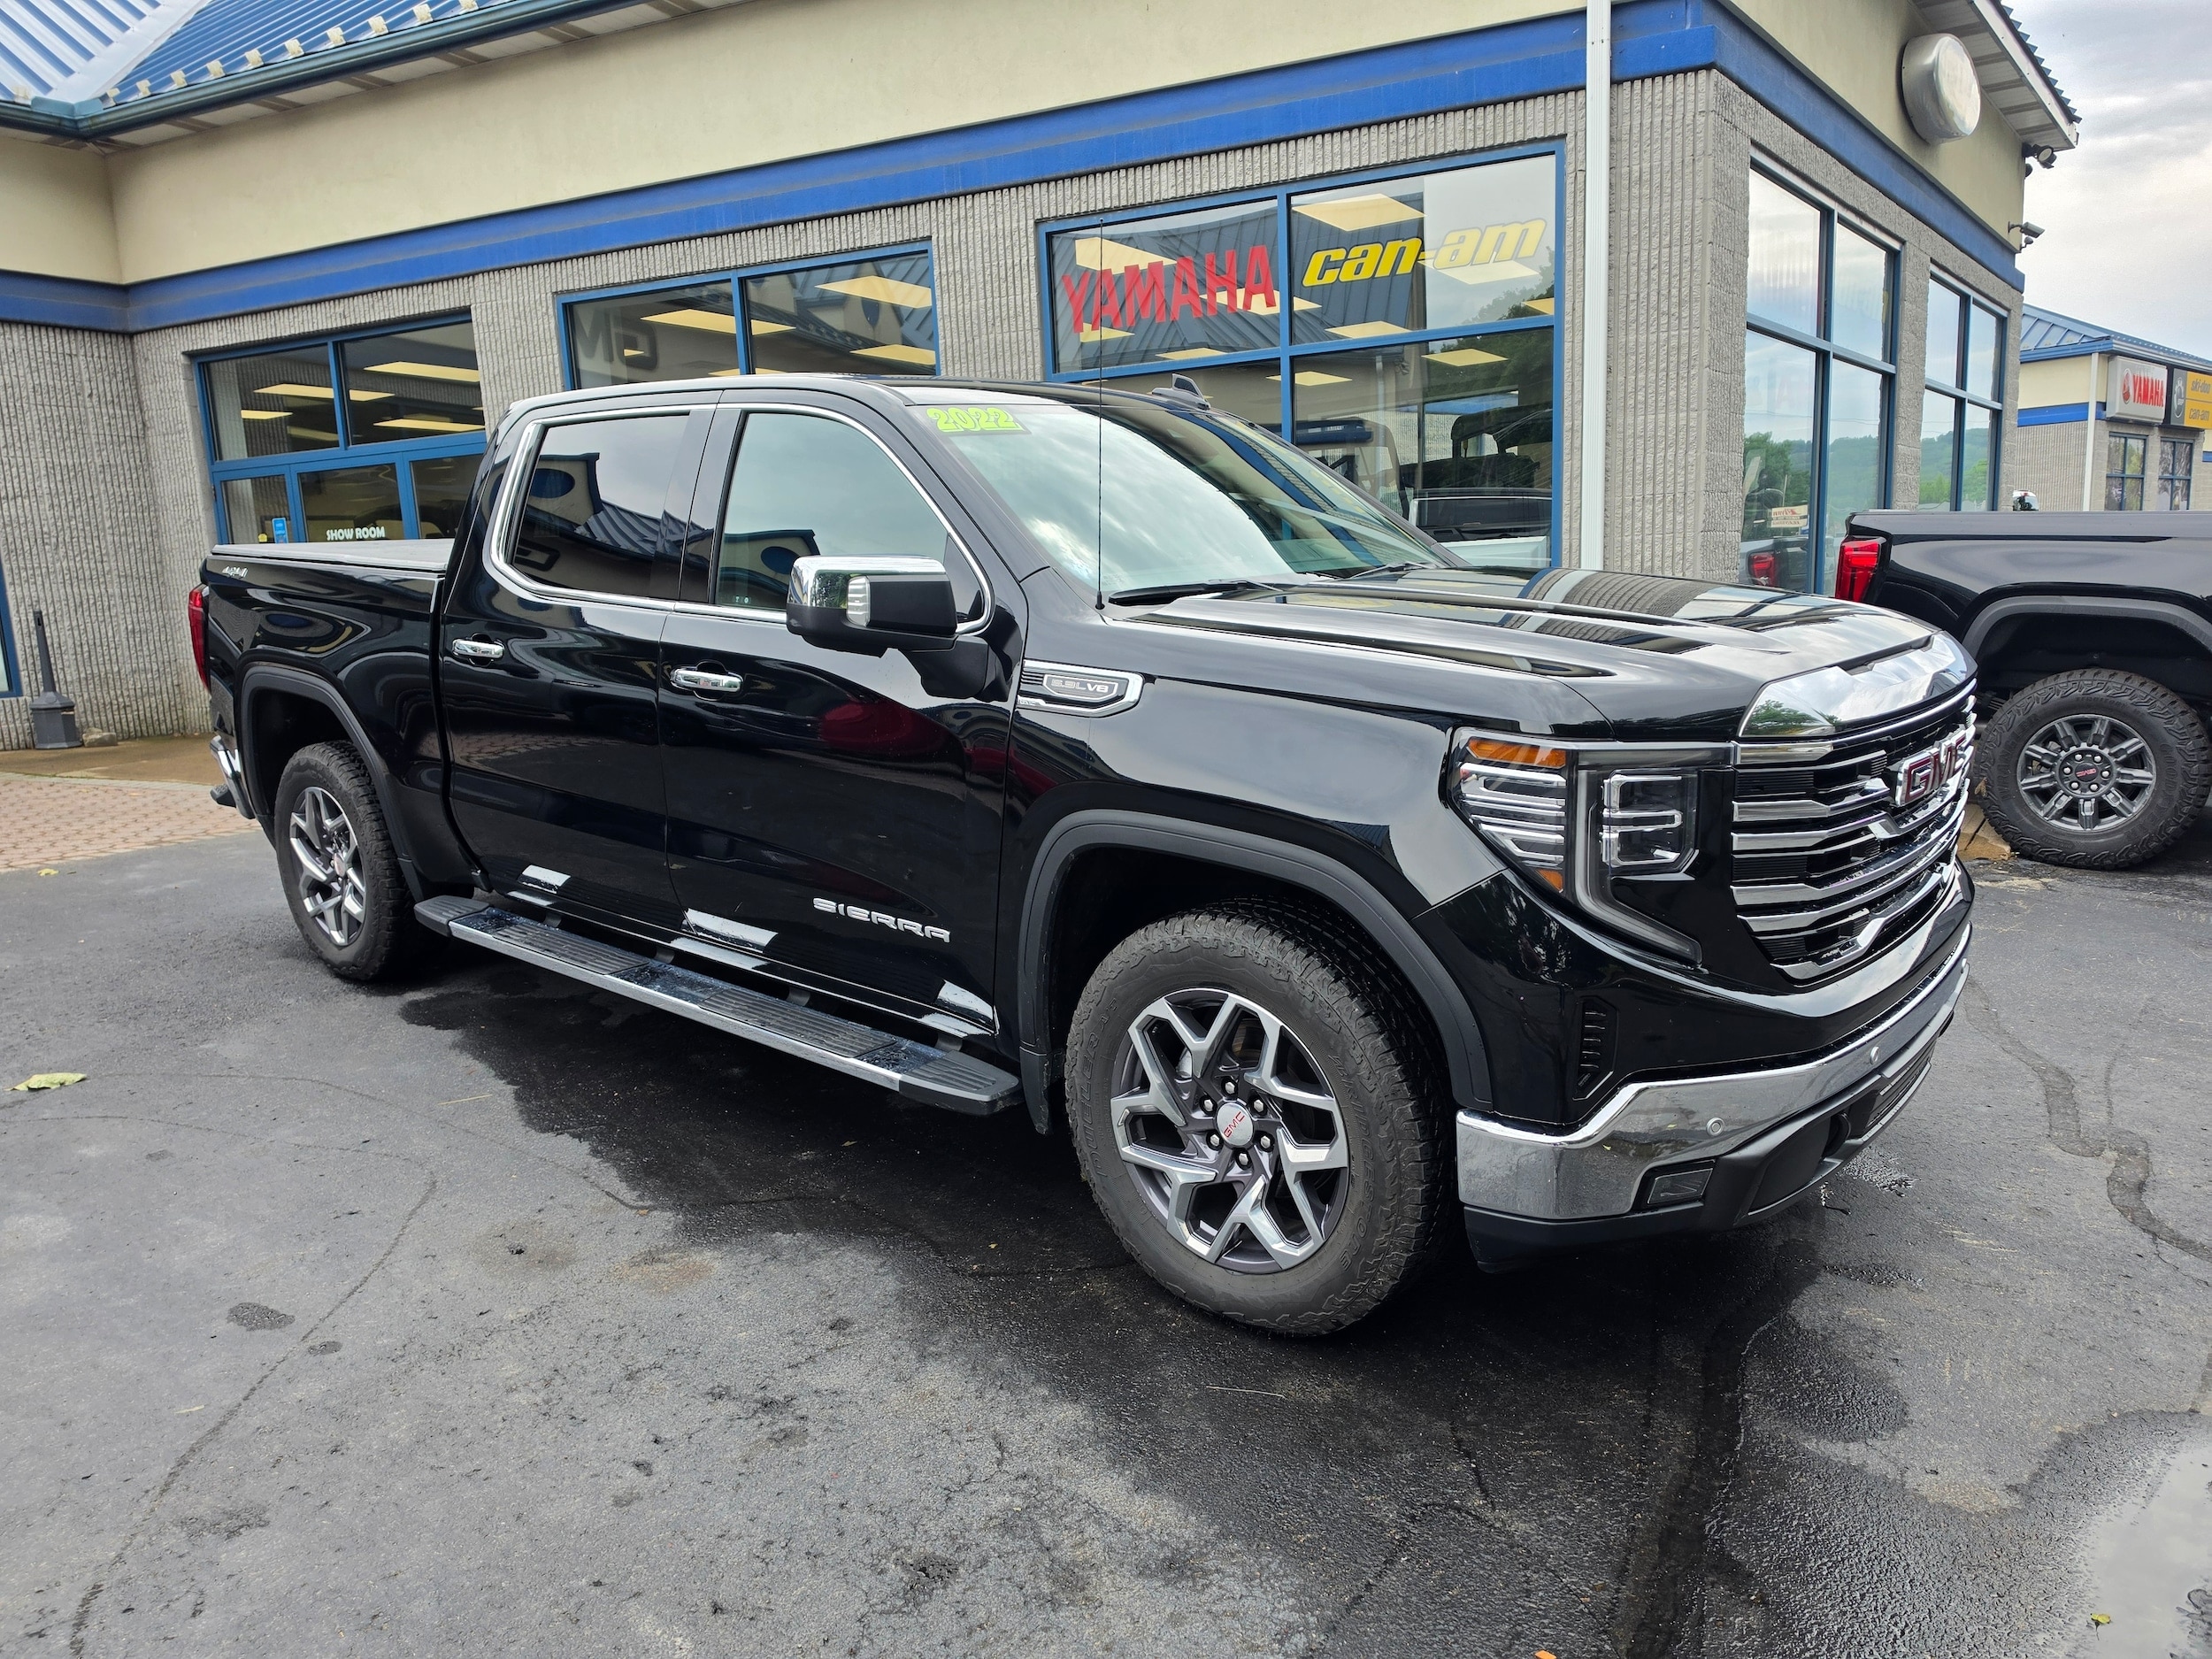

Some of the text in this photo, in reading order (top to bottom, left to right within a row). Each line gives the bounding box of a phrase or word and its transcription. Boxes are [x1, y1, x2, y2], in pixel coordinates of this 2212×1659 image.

[1302, 219, 1547, 288] can-am
[1061, 244, 1277, 334] YAMAHA
[2132, 375, 2163, 407] YAMAHA
[926, 407, 1025, 433] 2022
[326, 526, 386, 541] SHOW ROOM
[1895, 729, 1967, 807] GMC
[812, 897, 951, 943] SIERRA
[1224, 1111, 1246, 1138] GMC
[1327, 1054, 1376, 1271] BRIDGESTONE
